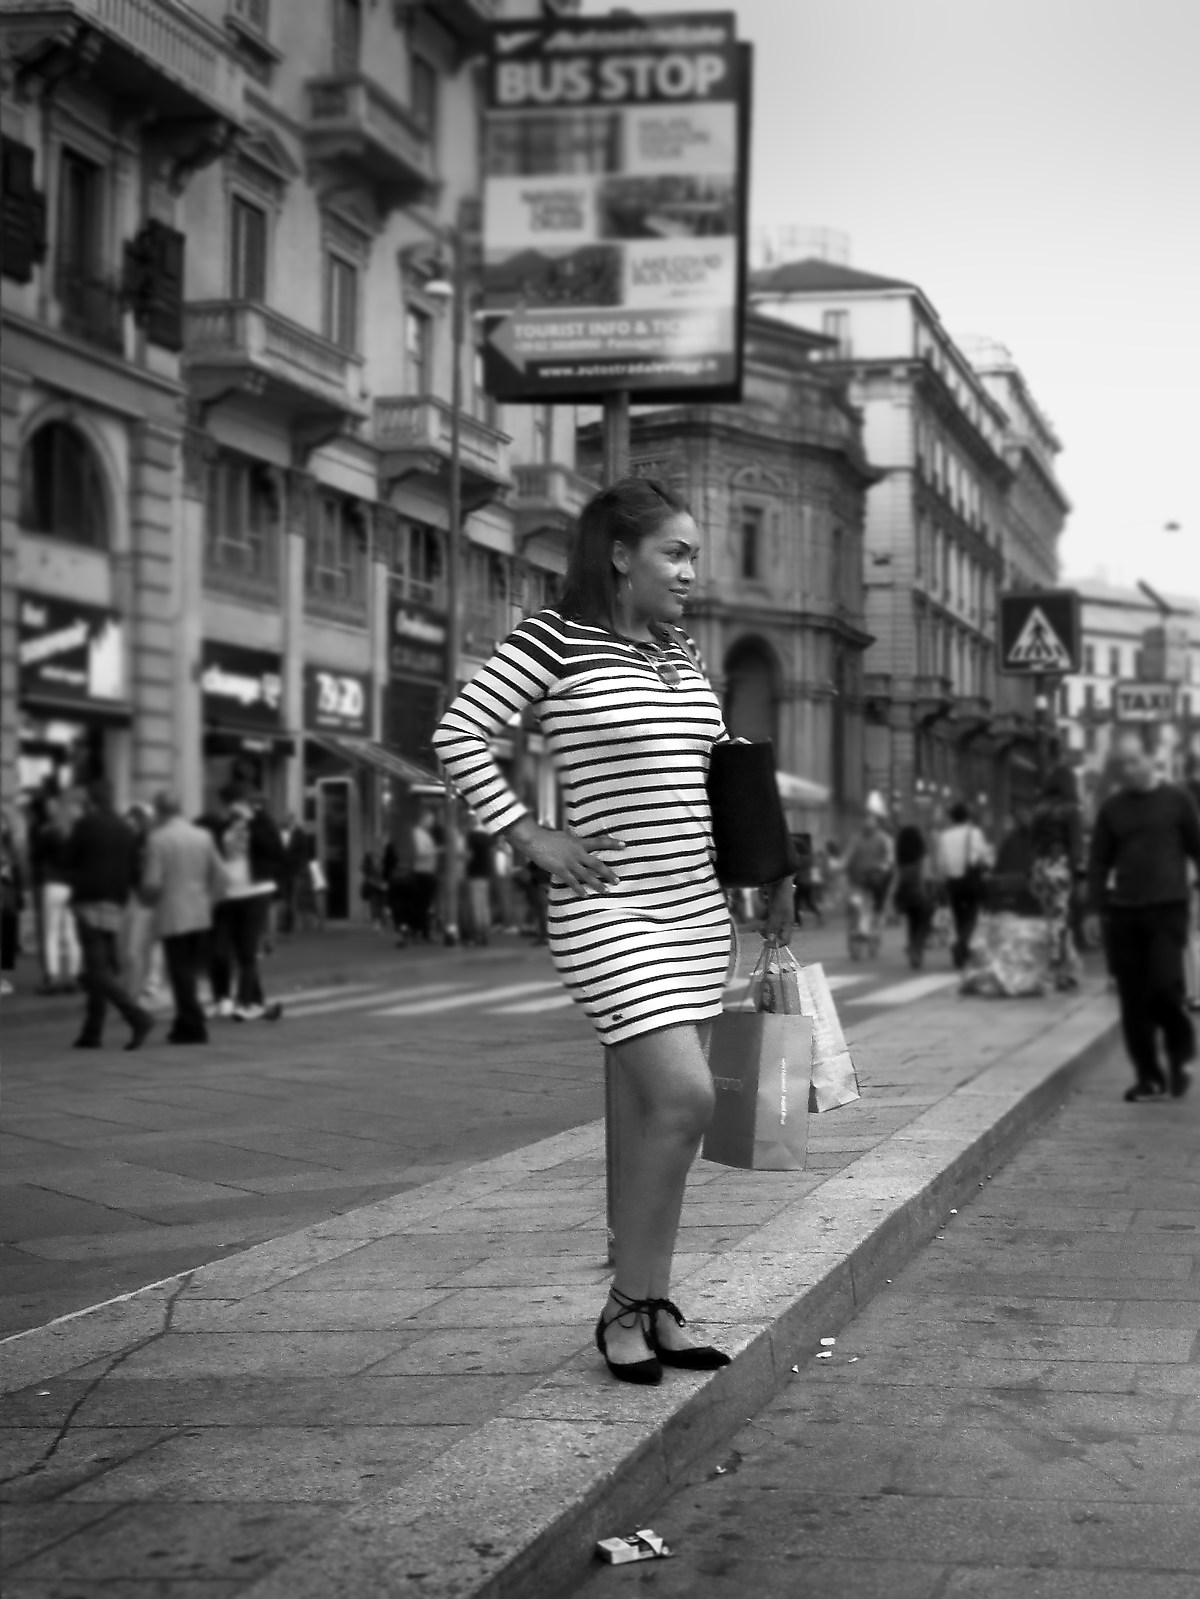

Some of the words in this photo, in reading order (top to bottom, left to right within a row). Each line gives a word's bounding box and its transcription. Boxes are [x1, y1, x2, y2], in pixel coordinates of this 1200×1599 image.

[498, 57, 592, 102] BUS
[599, 52, 726, 98] STOP
[513, 321, 584, 339] TOURIST
[588, 319, 630, 336] INFO
